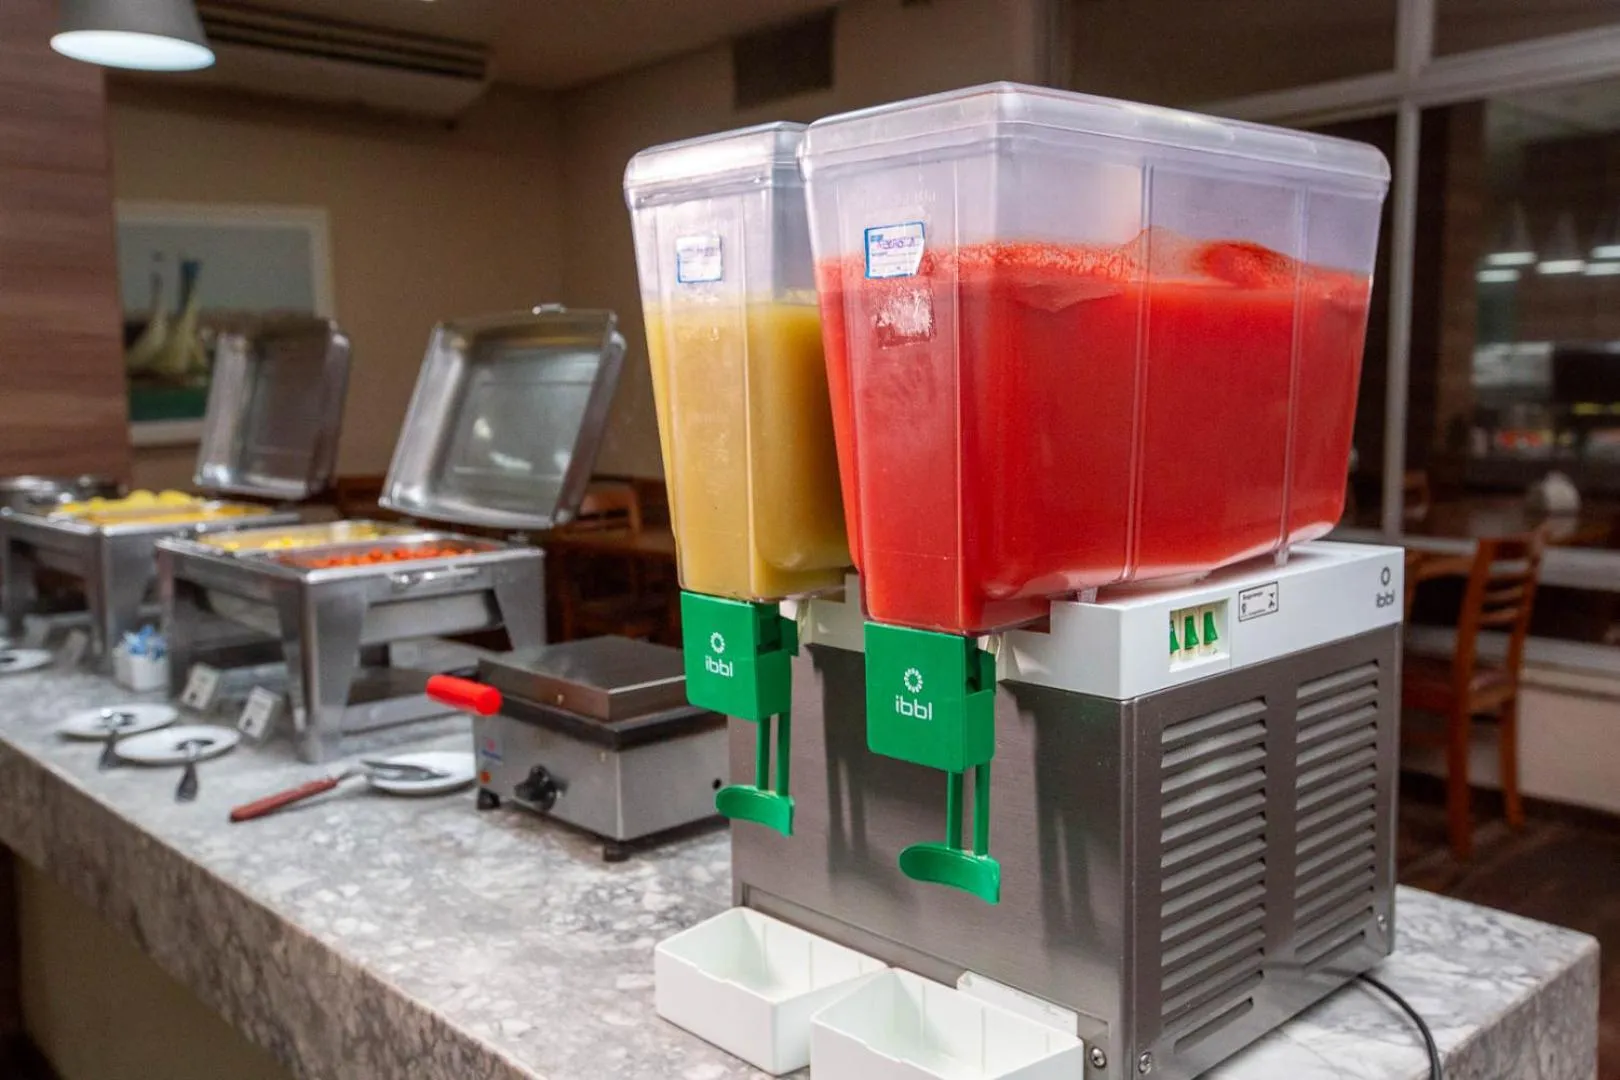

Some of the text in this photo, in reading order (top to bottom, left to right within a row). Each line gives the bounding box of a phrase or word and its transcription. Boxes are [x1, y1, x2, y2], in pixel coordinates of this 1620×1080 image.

[1375, 588, 1396, 608] ibbl
[704, 654, 734, 678] ibbl
[895, 694, 933, 721] ibbl
